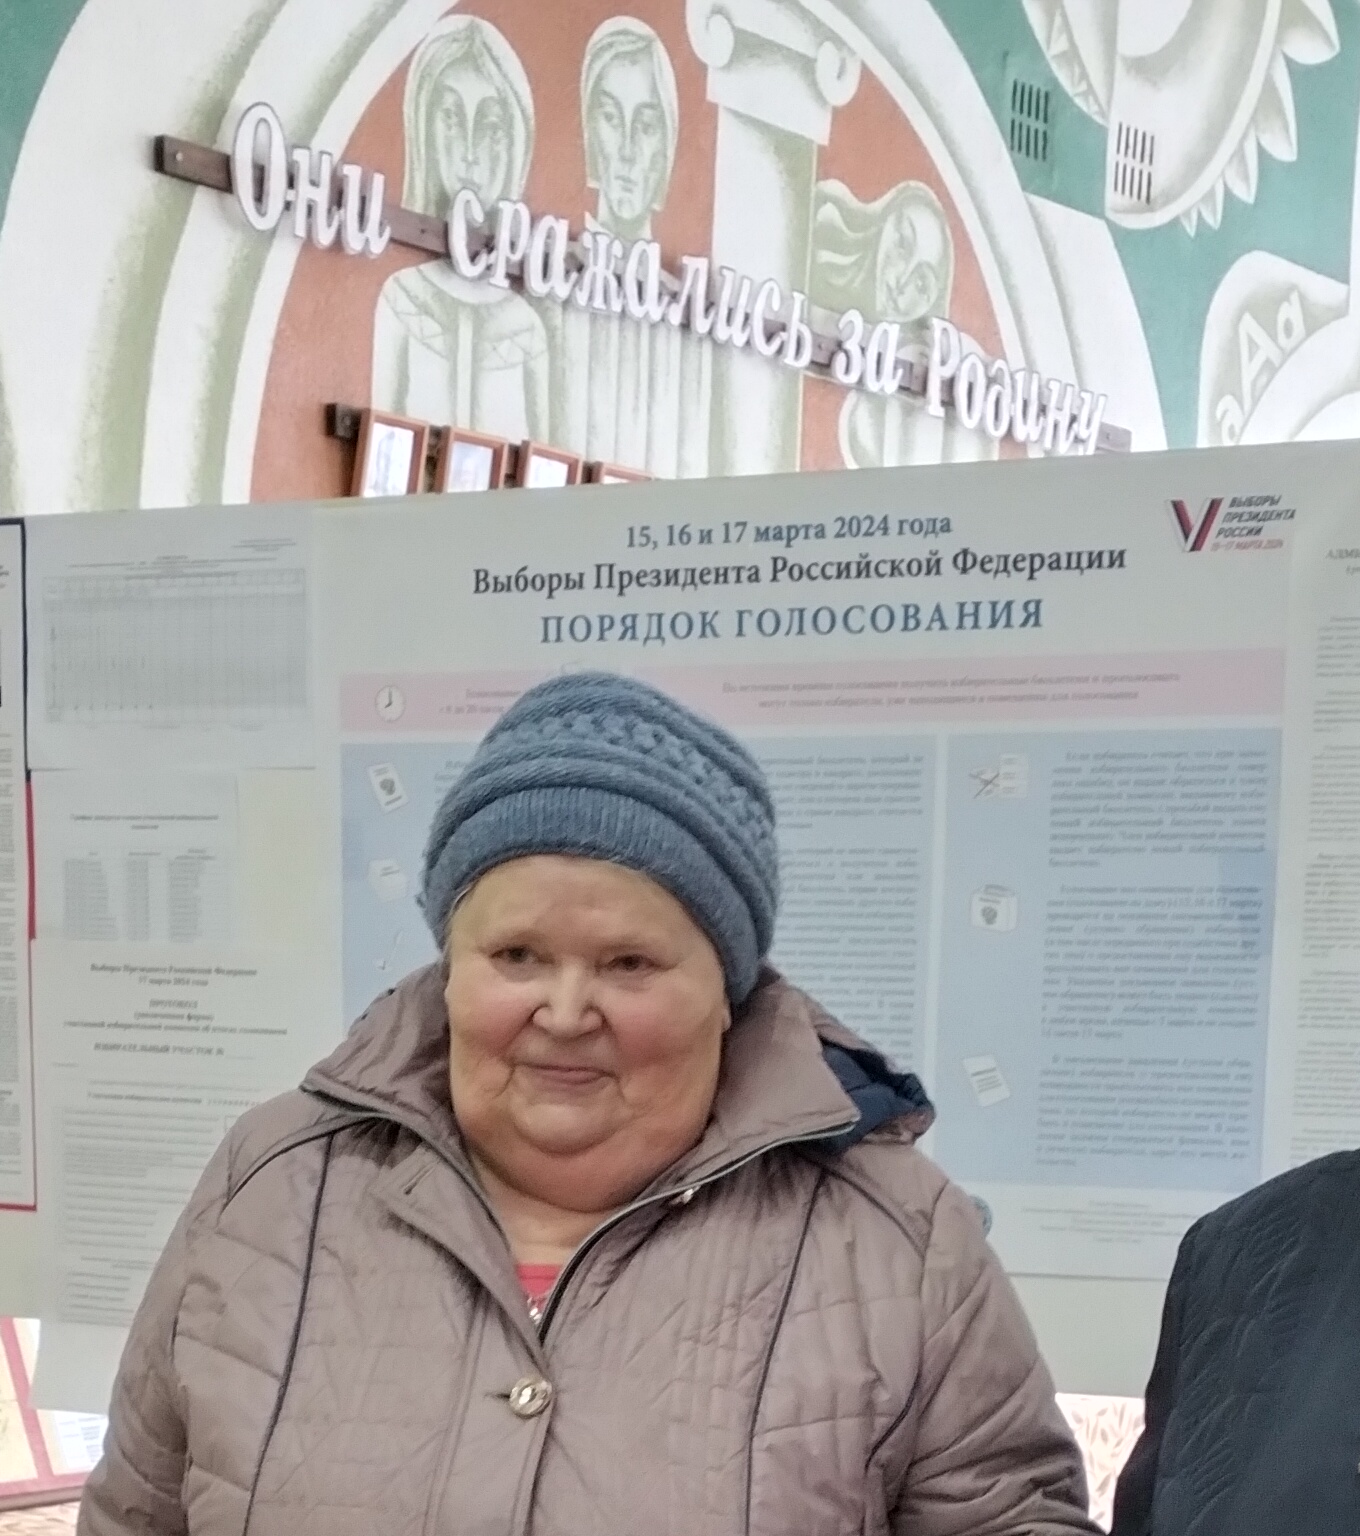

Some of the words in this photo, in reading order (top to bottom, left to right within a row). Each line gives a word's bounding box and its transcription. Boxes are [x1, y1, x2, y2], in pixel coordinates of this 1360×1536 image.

[233, 102, 392, 258] Они
[448, 188, 813, 368] сражались
[830, 309, 904, 395] за
[928, 316, 1108, 455] Родину
[628, 526, 658, 550] 15,
[667, 524, 692, 546] 16
[698, 529, 713, 545] и
[723, 521, 748, 544] 17
[754, 523, 826, 544] марта
[834, 515, 890, 538] 2024
[897, 517, 952, 538] года
[1222, 509, 1296, 523] ПРЕЗИДЕНТА
[474, 566, 584, 599] Выборы
[594, 564, 761, 596] Президента
[770, 551, 942, 582] Российской
[952, 549, 1126, 578] Федерации
[542, 611, 719, 644] ПОРЯДОК
[736, 599, 1042, 637] ГОЛОСОВАНИЯ
